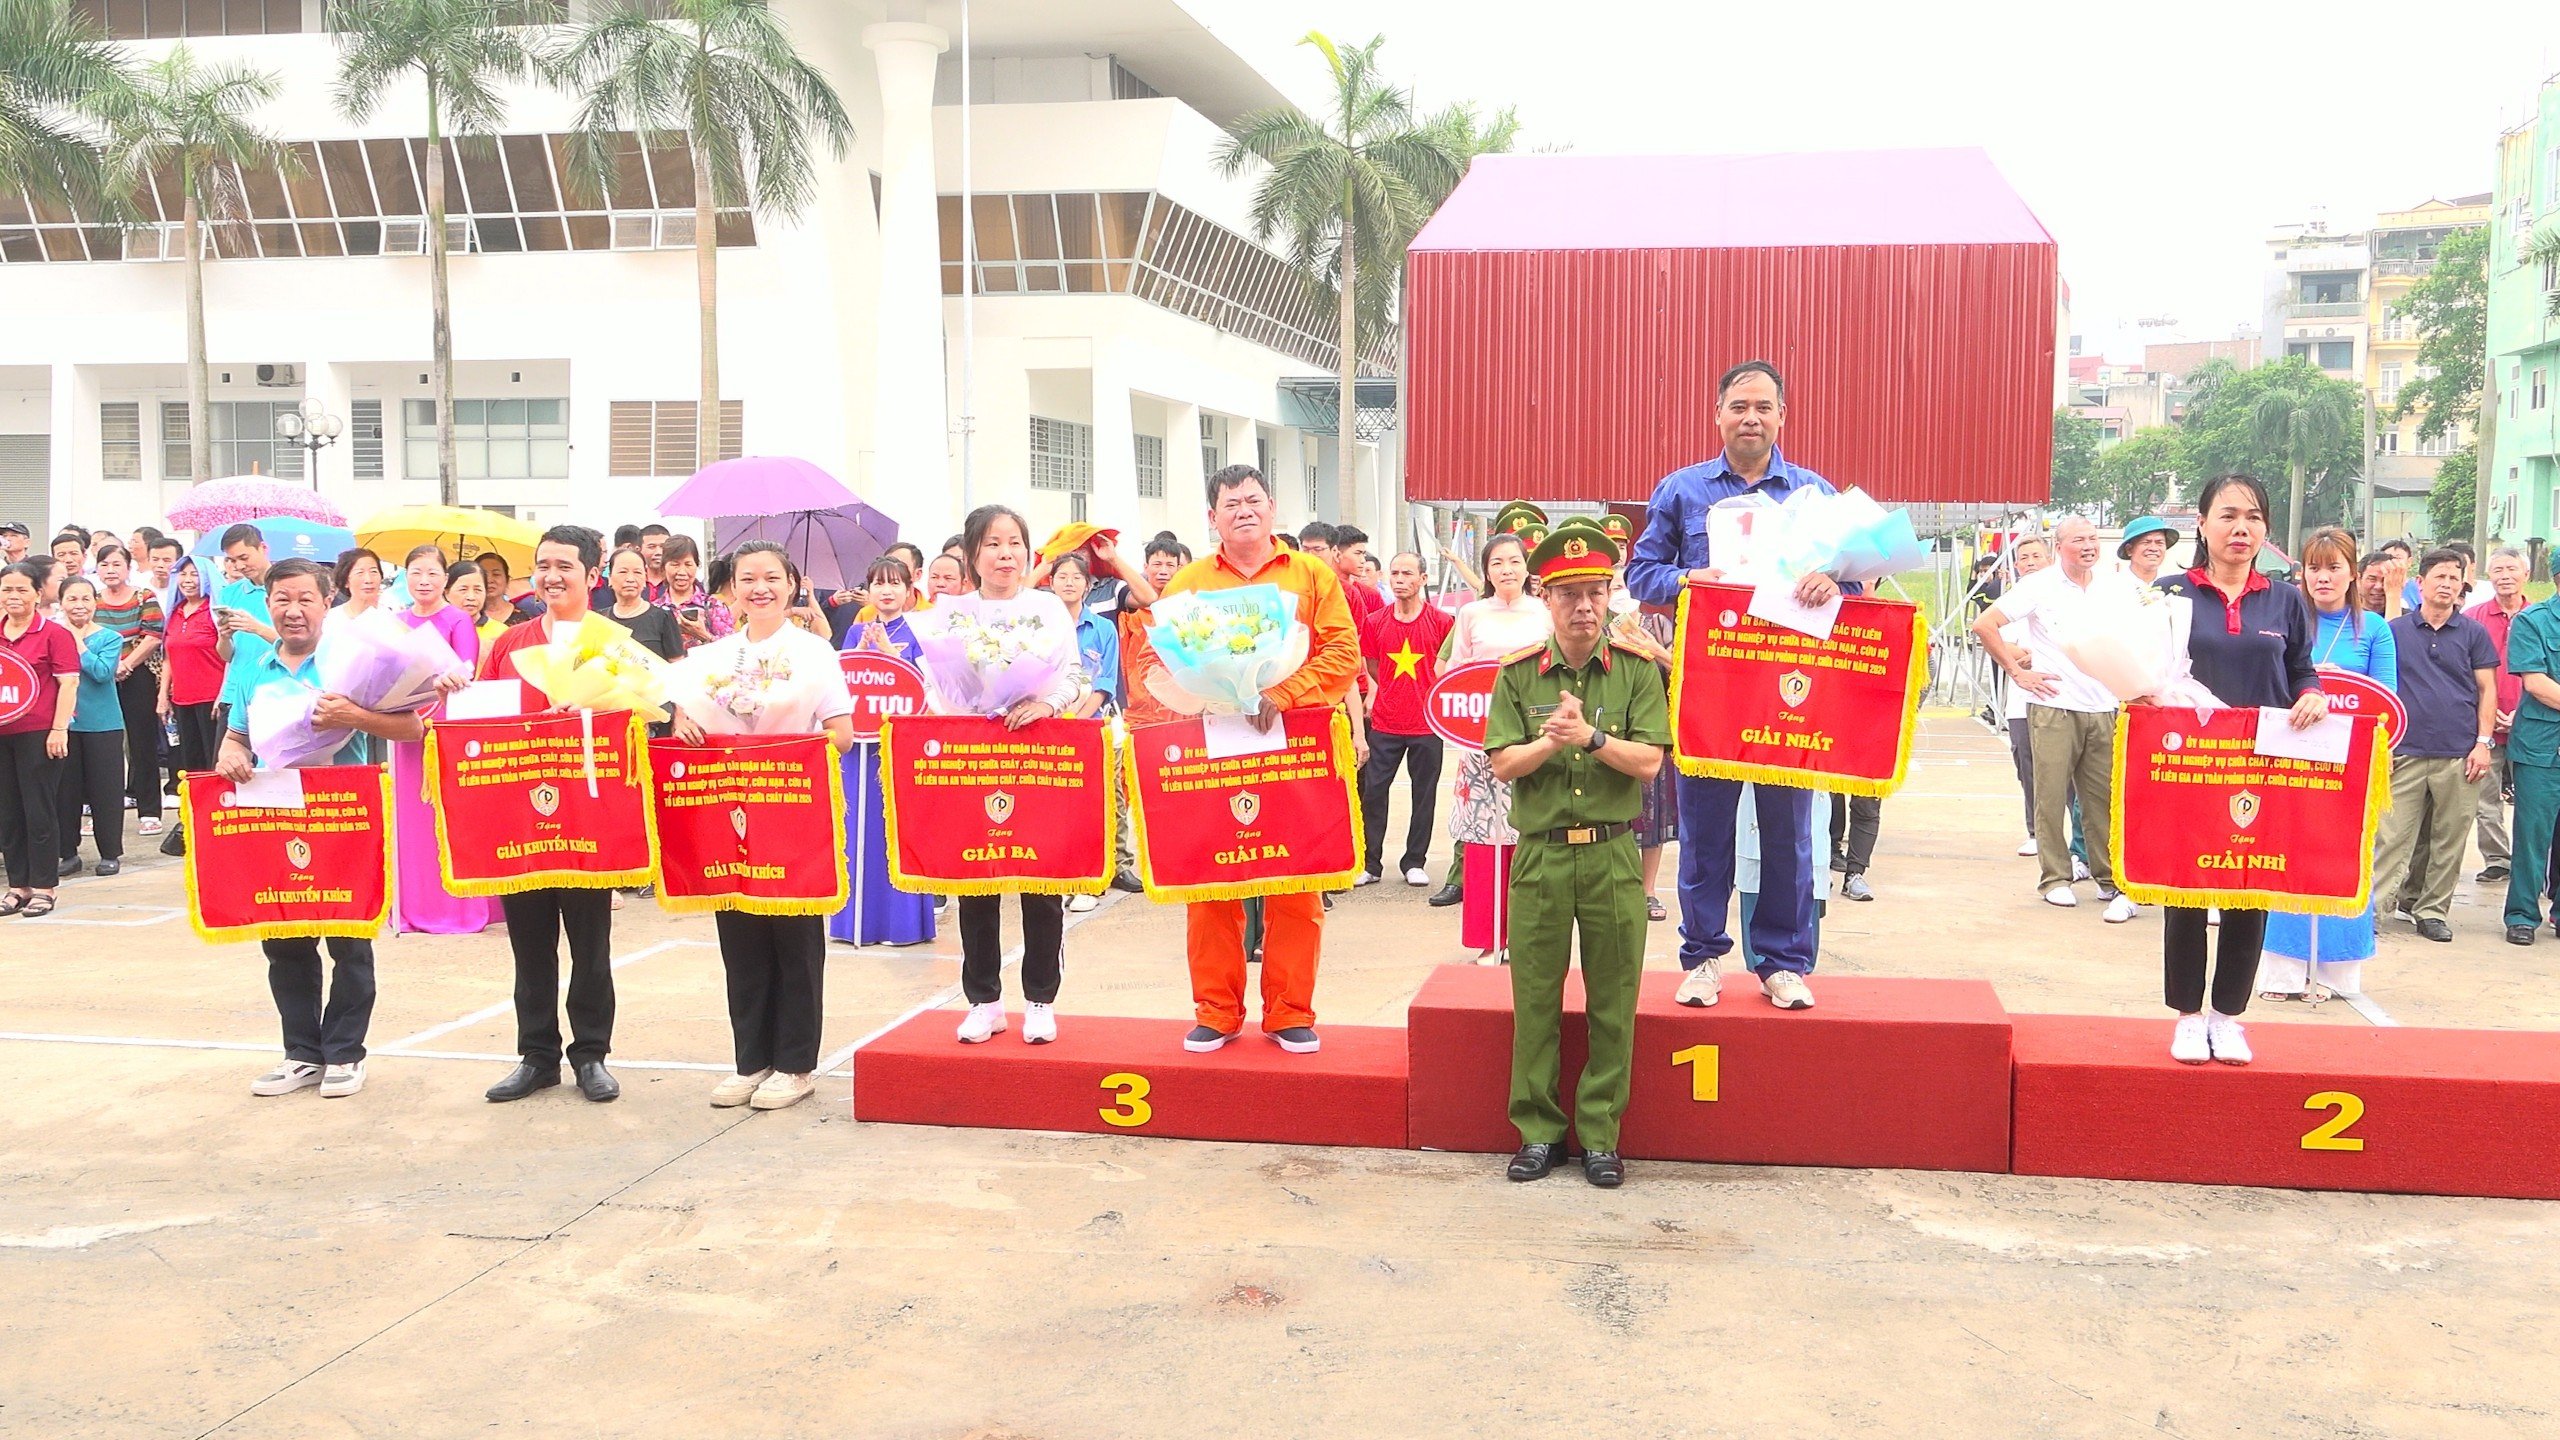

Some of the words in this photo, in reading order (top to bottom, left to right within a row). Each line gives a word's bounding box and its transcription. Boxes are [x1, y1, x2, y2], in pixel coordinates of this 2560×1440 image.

[841, 667, 896, 686] HƯỜNG
[0, 685, 19, 704] AI
[1741, 725, 1781, 746] GIẢI
[1785, 731, 1833, 751] NHẤT
[496, 840, 523, 860] GIẢI
[523, 834, 568, 856] KHUYẾN
[569, 837, 598, 853] KHÍCH
[962, 843, 1006, 861] GIẢI
[1011, 846, 1038, 860] BA
[1215, 845, 1257, 865] GIẢI
[1262, 844, 1290, 859] BA
[703, 860, 728, 879] GIẢI
[752, 863, 786, 880] KHÍCH
[2197, 850, 2244, 869] GIẢI
[2248, 853, 2286, 872] NHÌ
[255, 886, 279, 904] GIẢI
[279, 885, 321, 903] KHUYẾN
[322, 887, 352, 903] KHÍCH
[1671, 1044, 1719, 1102] 1
[1099, 1072, 1152, 1127] 3
[2301, 1091, 2365, 1151] 2
